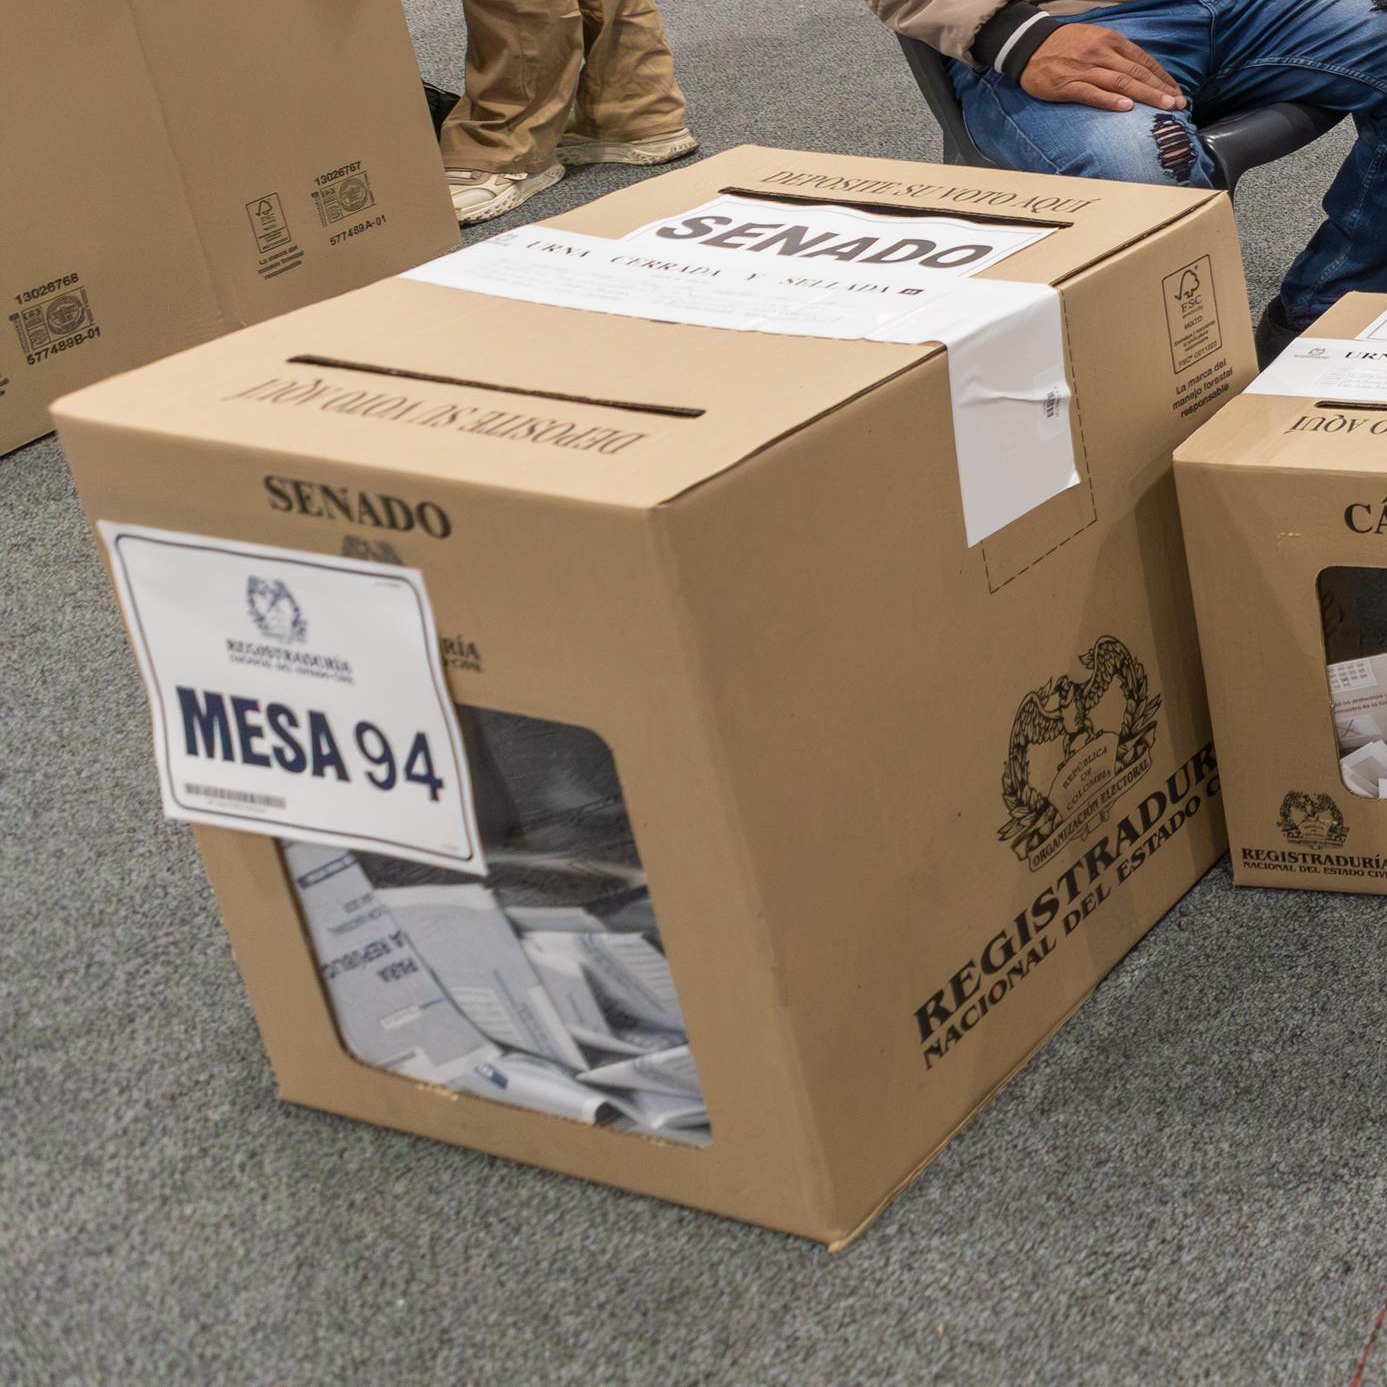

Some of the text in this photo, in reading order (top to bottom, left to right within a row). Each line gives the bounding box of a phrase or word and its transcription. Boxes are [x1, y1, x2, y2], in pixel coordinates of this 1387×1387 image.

[761, 170, 1102, 215] DEPOSITE SU VOTO AQUÍ
[655, 214, 994, 269] SENADO
[526, 240, 591, 259] URNA
[609, 254, 723, 279] CERRADA
[784, 276, 893, 296] SELLADA
[1181, 295, 1203, 314] FSC
[1172, 367, 1233, 411] manejo forestal
[1175, 357, 1227, 395] La marca del
[221, 376, 652, 455] DEPOSITE SU VOTO AQUÍ
[1285, 415, 1368, 436] AQUÍ
[263, 474, 453, 540] SENADO
[175, 685, 446, 802] MESA 94
[1062, 746, 1108, 790] REPÚBLICA
[1100, 758, 1150, 805] ELECTORAL
[1243, 861, 1296, 874] NACIONAL
[1299, 864, 1321, 875] DEL
[1323, 865, 1365, 877] ESTADO
[920, 801, 1201, 1071] NACIONAL DEL ESTADO
